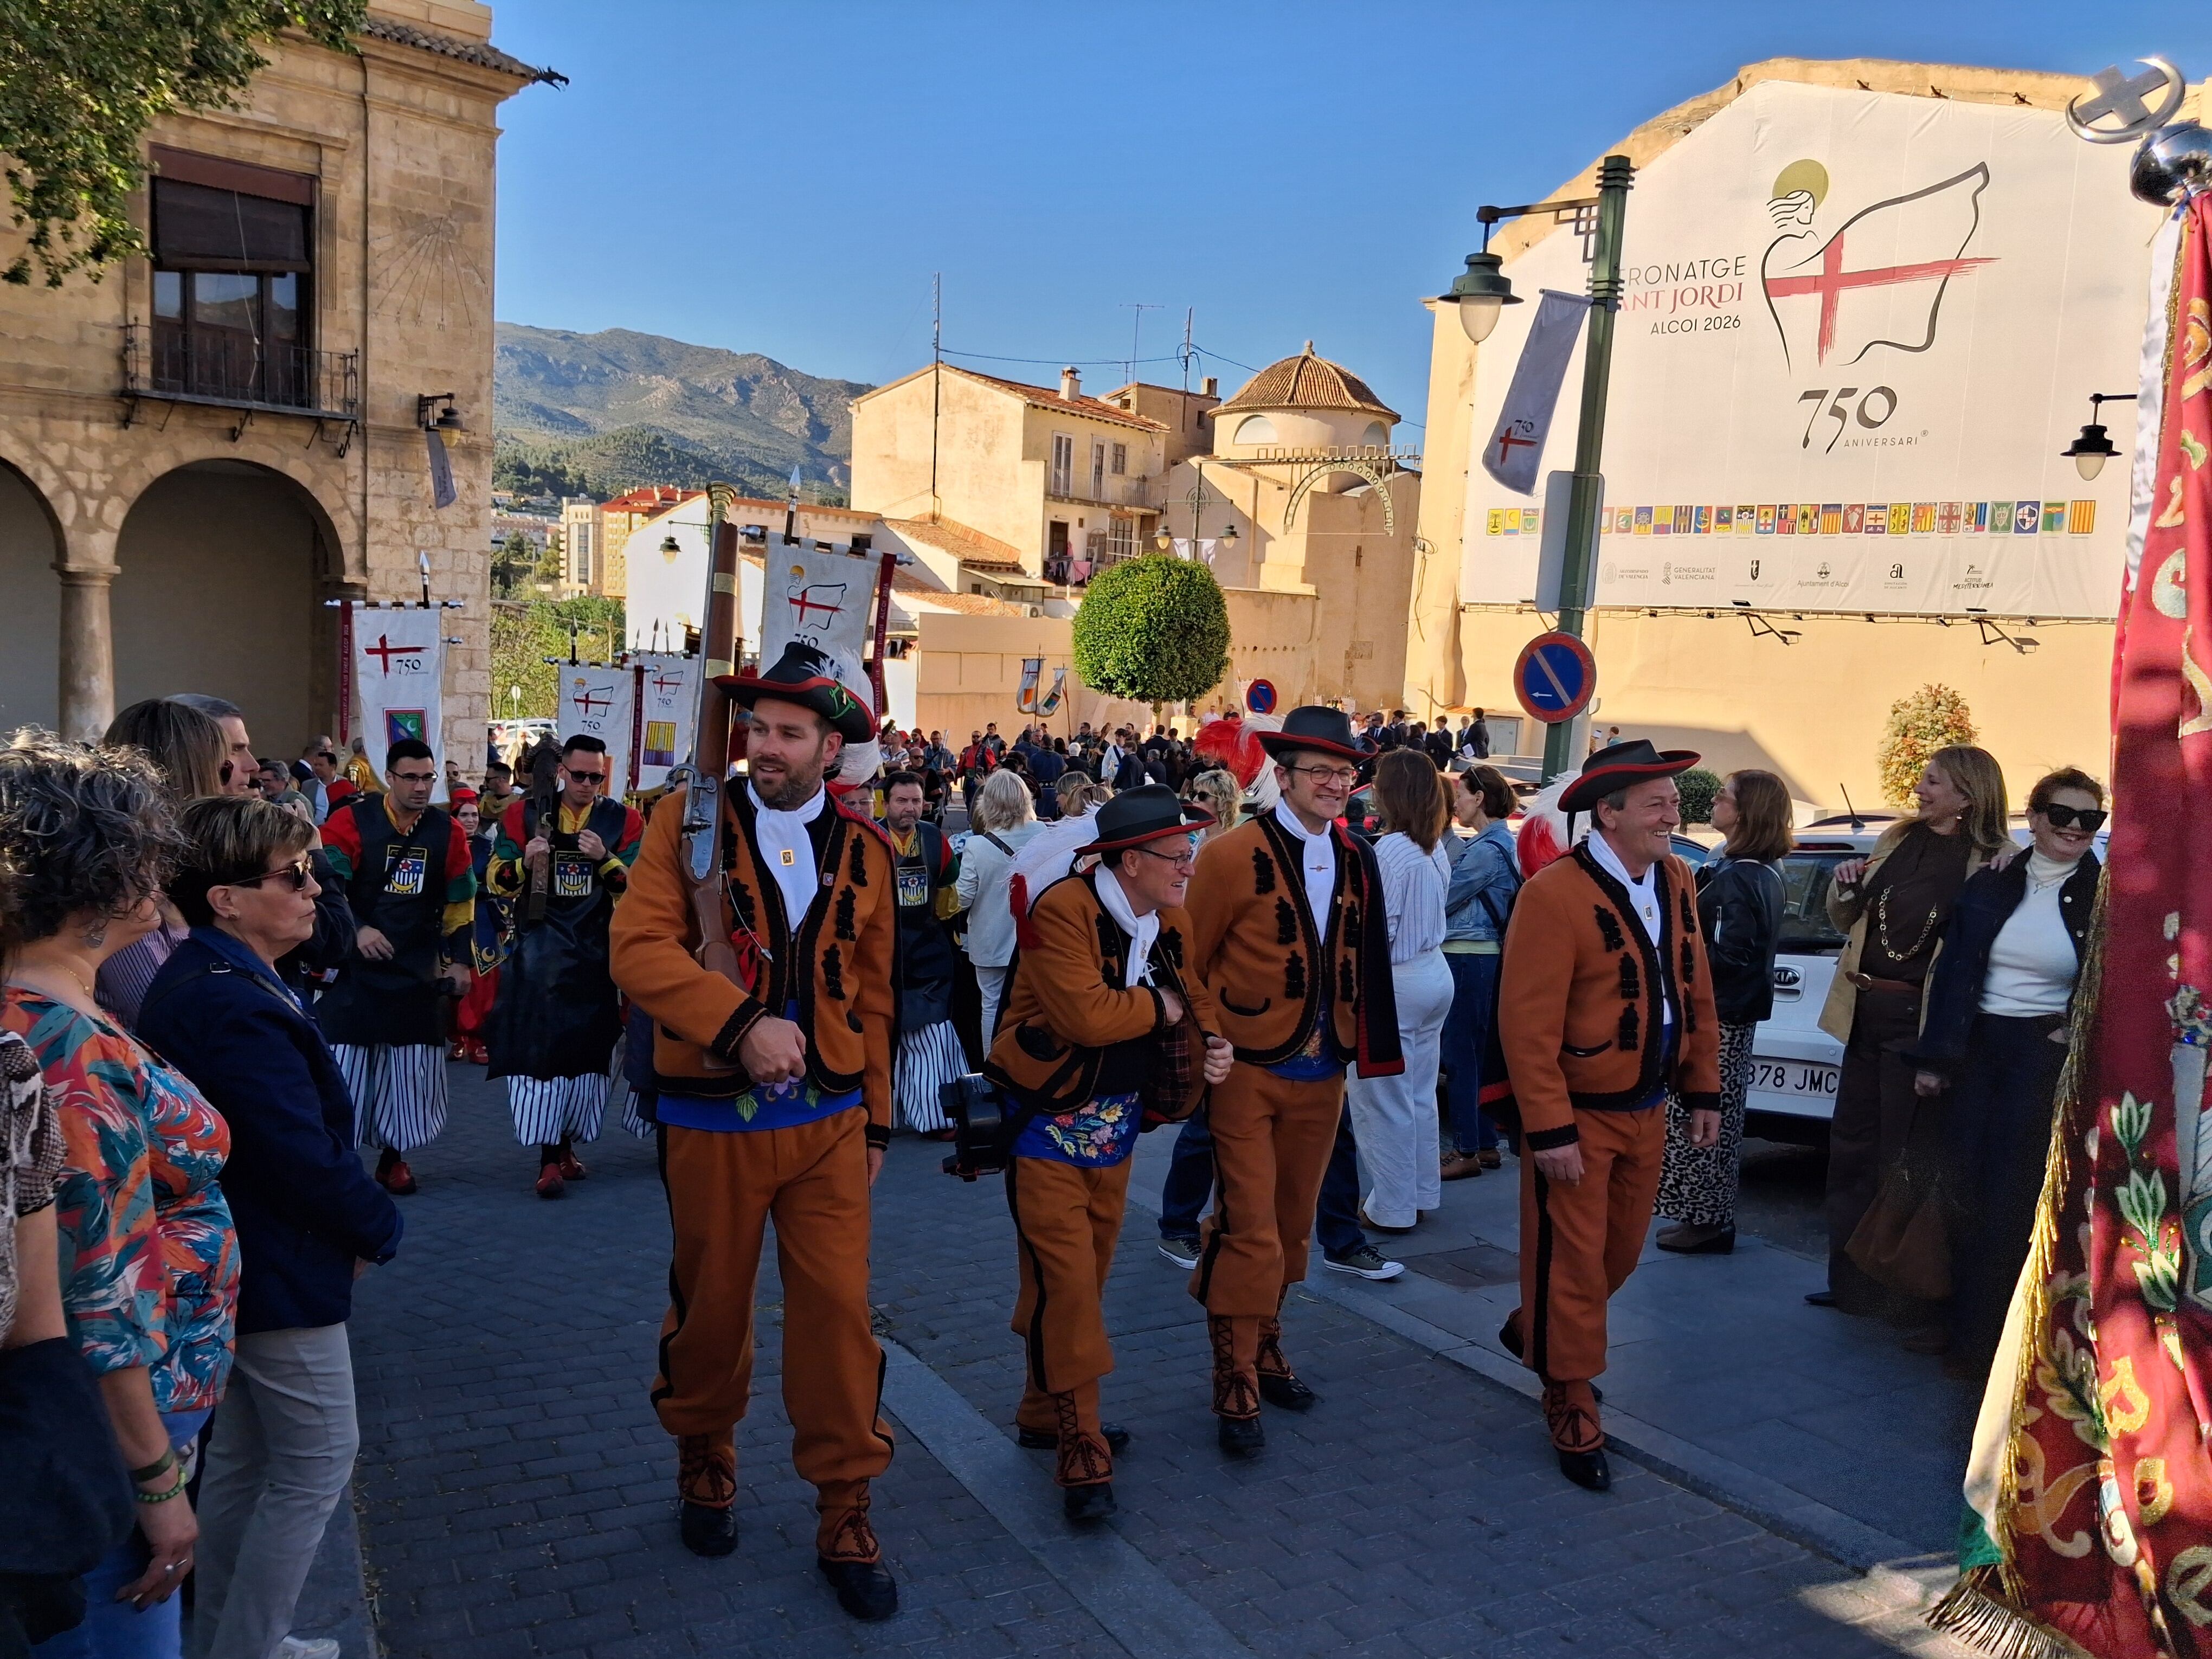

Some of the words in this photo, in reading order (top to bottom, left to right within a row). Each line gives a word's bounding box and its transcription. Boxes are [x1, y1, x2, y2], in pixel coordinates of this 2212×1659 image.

[1587, 256, 1746, 286] RONATGE
[1669, 282, 1743, 314] JORDI
[1650, 319, 1697, 335] ALCOI
[1704, 315, 1741, 331] 2026
[1514, 420, 1534, 438] 750
[1797, 386, 1897, 455] 750
[1844, 436, 1918, 448] ANIVERSARI
[396, 659, 421, 676] 750
[581, 720, 601, 733] 750
[1773, 971, 1794, 982] KIA
[1747, 1064, 1785, 1088] 378
[1794, 1069, 1838, 1094] JMC
